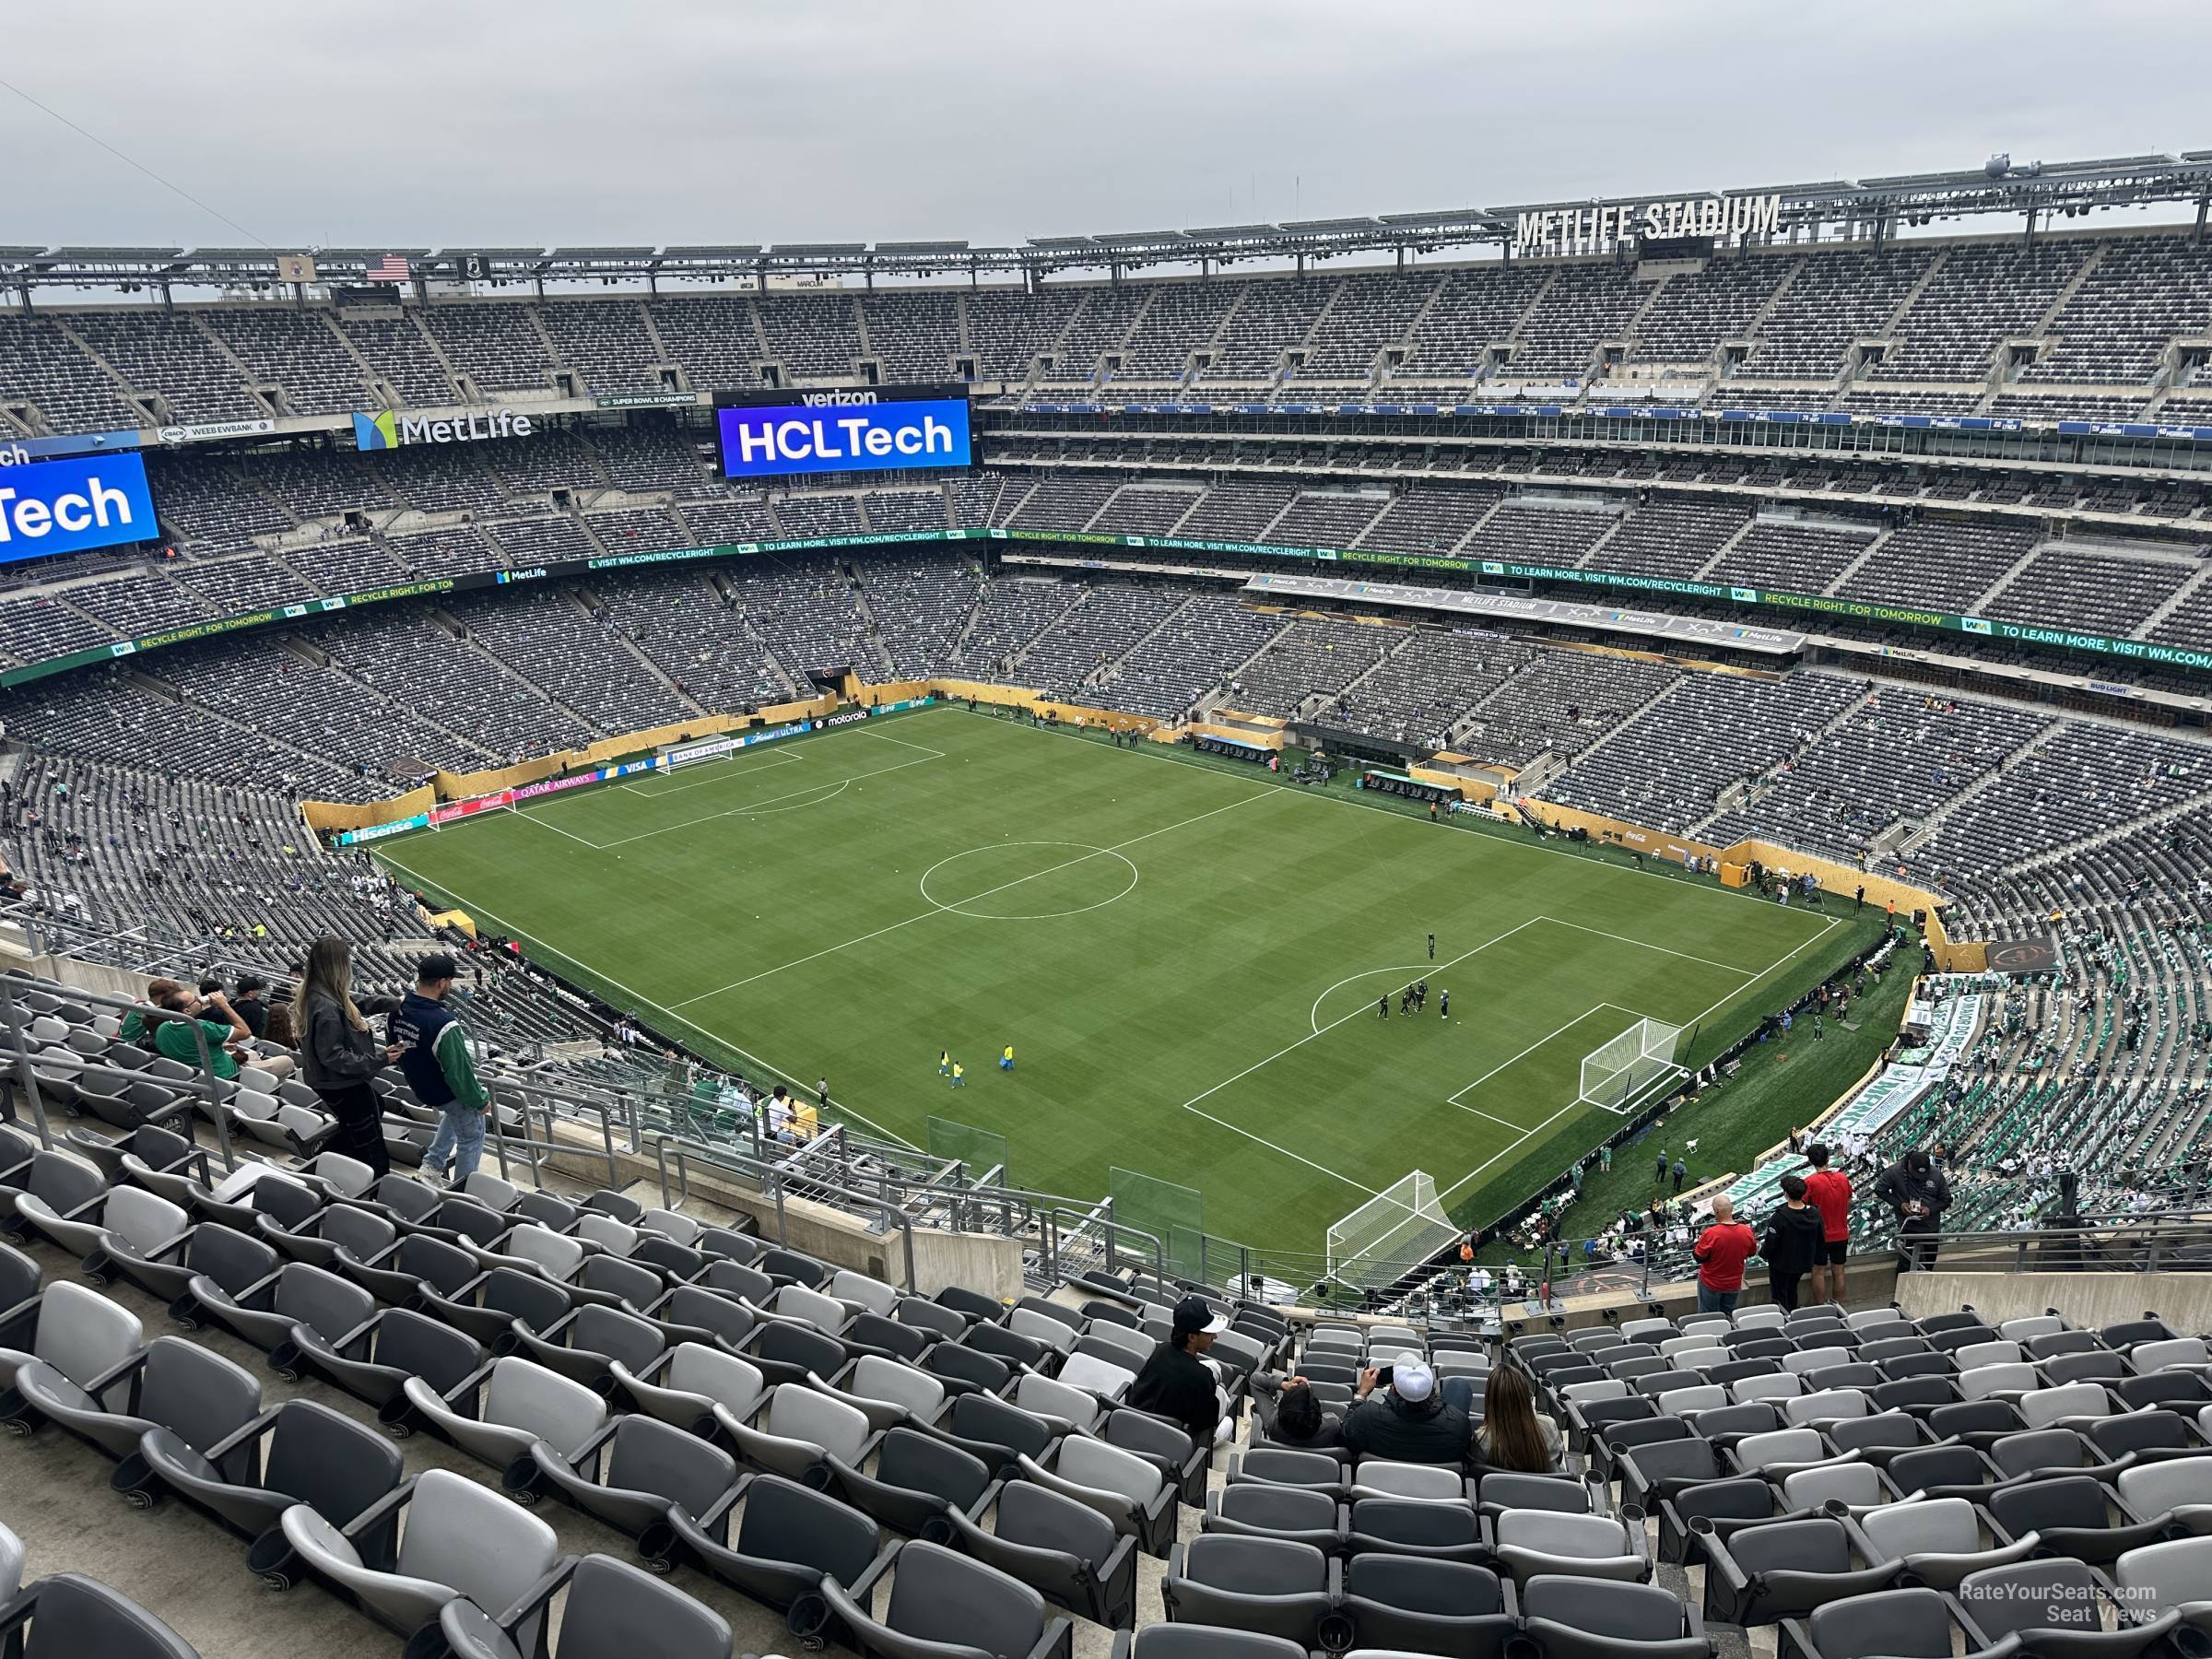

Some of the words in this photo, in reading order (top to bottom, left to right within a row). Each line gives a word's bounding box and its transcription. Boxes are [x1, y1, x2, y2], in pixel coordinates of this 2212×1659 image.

[1516, 206, 1636, 247] METLIFE
[1641, 194, 1782, 241] STADIUM
[612, 397, 633, 406] SUPER
[634, 396, 653, 405] BOWL
[659, 394, 696, 403] CHAMPIONS
[802, 389, 877, 407] verizon
[164, 429, 185, 439] COACH
[192, 427, 217, 436] WEEB
[218, 424, 253, 434] EWBANK
[402, 408, 532, 445] MetLife
[738, 416, 953, 463] HCLTech
[776, 541, 802, 550] LEARN
[804, 539, 829, 548] MORE,
[830, 538, 848, 547] VISIT
[849, 532, 939, 546] WM.COM/RECYCLERIGHT
[1012, 532, 1040, 540] RECYCLE
[1041, 533, 1061, 542] RIGHT,
[1063, 534, 1077, 542] FOR
[1077, 535, 1115, 544] TOMORROW
[1160, 540, 1182, 548] LEARN
[1183, 541, 1206, 551] MORE,
[1206, 542, 1224, 550] VISIT
[1225, 543, 1311, 558] WM.COM/RECYCLERIGHT
[597, 557, 617, 568] VISIT
[618, 547, 714, 566] WM.COM/RECYCLERIGHT
[1343, 552, 1376, 564] RECYCLE
[1377, 555, 1402, 566] RIGHT,
[1404, 557, 1419, 566] FOR
[1421, 558, 1469, 571] TOMORROW
[512, 568, 547, 581] MetLife
[1274, 578, 1297, 587] MetLife
[1511, 566, 1523, 574] TO
[1524, 568, 1553, 579] LEARN
[1554, 571, 1583, 582] MORE,
[1584, 572, 1606, 583] VISIT
[1608, 575, 1722, 596] WM.COM/RECYCLERIGHT
[351, 591, 388, 604] RECYCLE
[390, 587, 418, 598] RIGHT,
[418, 582, 436, 593] FOR
[1368, 586, 1394, 595] MetLife
[1461, 595, 1496, 607] METLIFE
[1497, 598, 1536, 611] STADIUM
[1765, 593, 1811, 608] RECYCLE
[1813, 599, 1846, 614] RIGHT,
[1849, 605, 1871, 616] FOR
[1874, 606, 1942, 626] TOMORROW
[1625, 614, 1656, 625] MetLife
[141, 633, 178, 648] RECYCLE
[178, 628, 205, 640] RIGHT,
[206, 622, 223, 633] FOR
[225, 612, 272, 630] TOMORROW
[1747, 631, 1783, 643] MetLife
[2002, 625, 2019, 637] TO
[2021, 628, 2064, 645] LEARN
[2066, 634, 2109, 653] MORE,
[2112, 641, 2146, 656] VISIT
[1892, 649, 1915, 658] MetLife
[2090, 682, 2106, 691] BUD
[2106, 685, 2127, 695] LIGHT
[886, 704, 896, 712] PIF
[915, 699, 926, 707] PIF
[828, 711, 867, 727] motorola
[781, 725, 804, 736] ULTRA
[673, 750, 692, 761] BANK
[693, 748, 703, 758] OF
[703, 741, 735, 756] AMERICA
[625, 760, 647, 773] VISA
[521, 783, 551, 799] QATAR
[553, 774, 590, 790] AIRWAYS
[352, 820, 414, 843] Hisense
